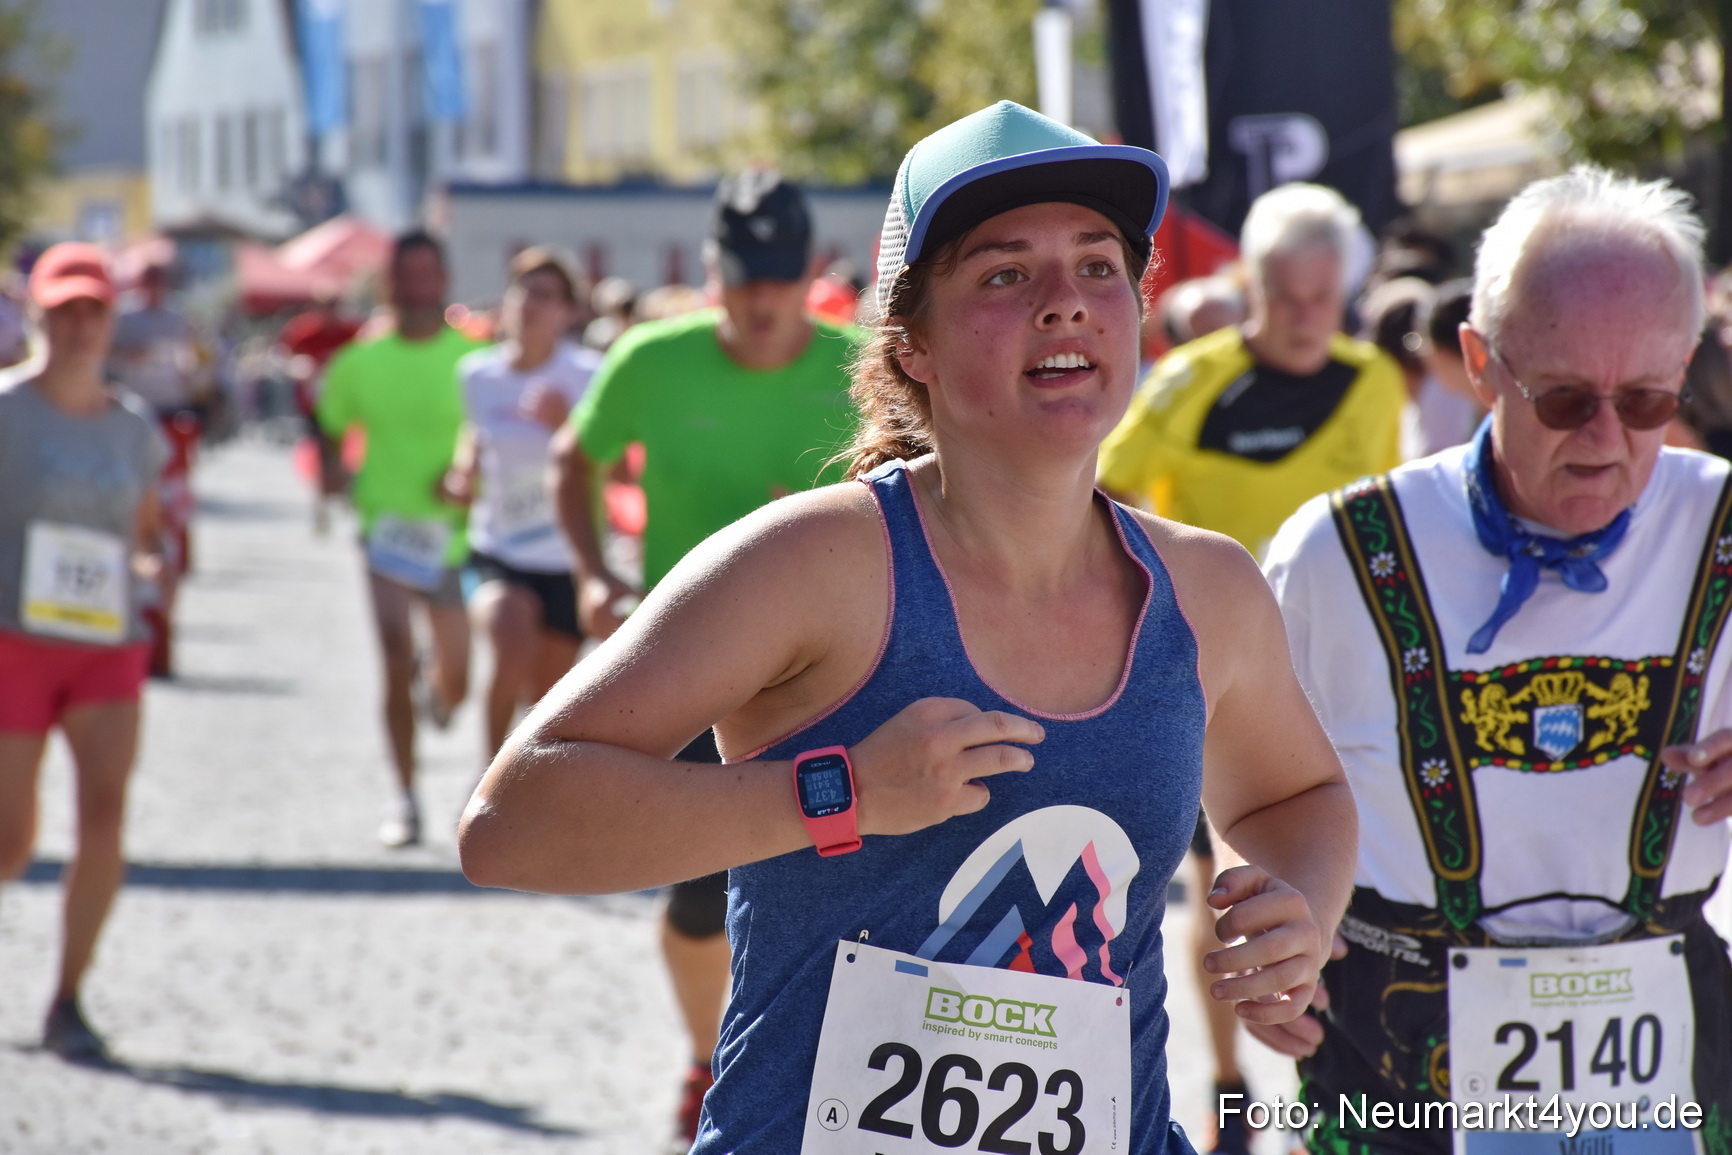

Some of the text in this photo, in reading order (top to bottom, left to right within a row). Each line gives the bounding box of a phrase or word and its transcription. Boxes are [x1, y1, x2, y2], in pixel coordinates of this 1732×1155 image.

[1530, 968, 1633, 998] BOCK
[925, 987, 1058, 1038] BOCK
[922, 1020, 1058, 1050] inspired by smart concepts
[1495, 1013, 1663, 1092] 2140
[826, 1106, 839, 1124] A
[857, 1042, 1086, 1155] 2623
